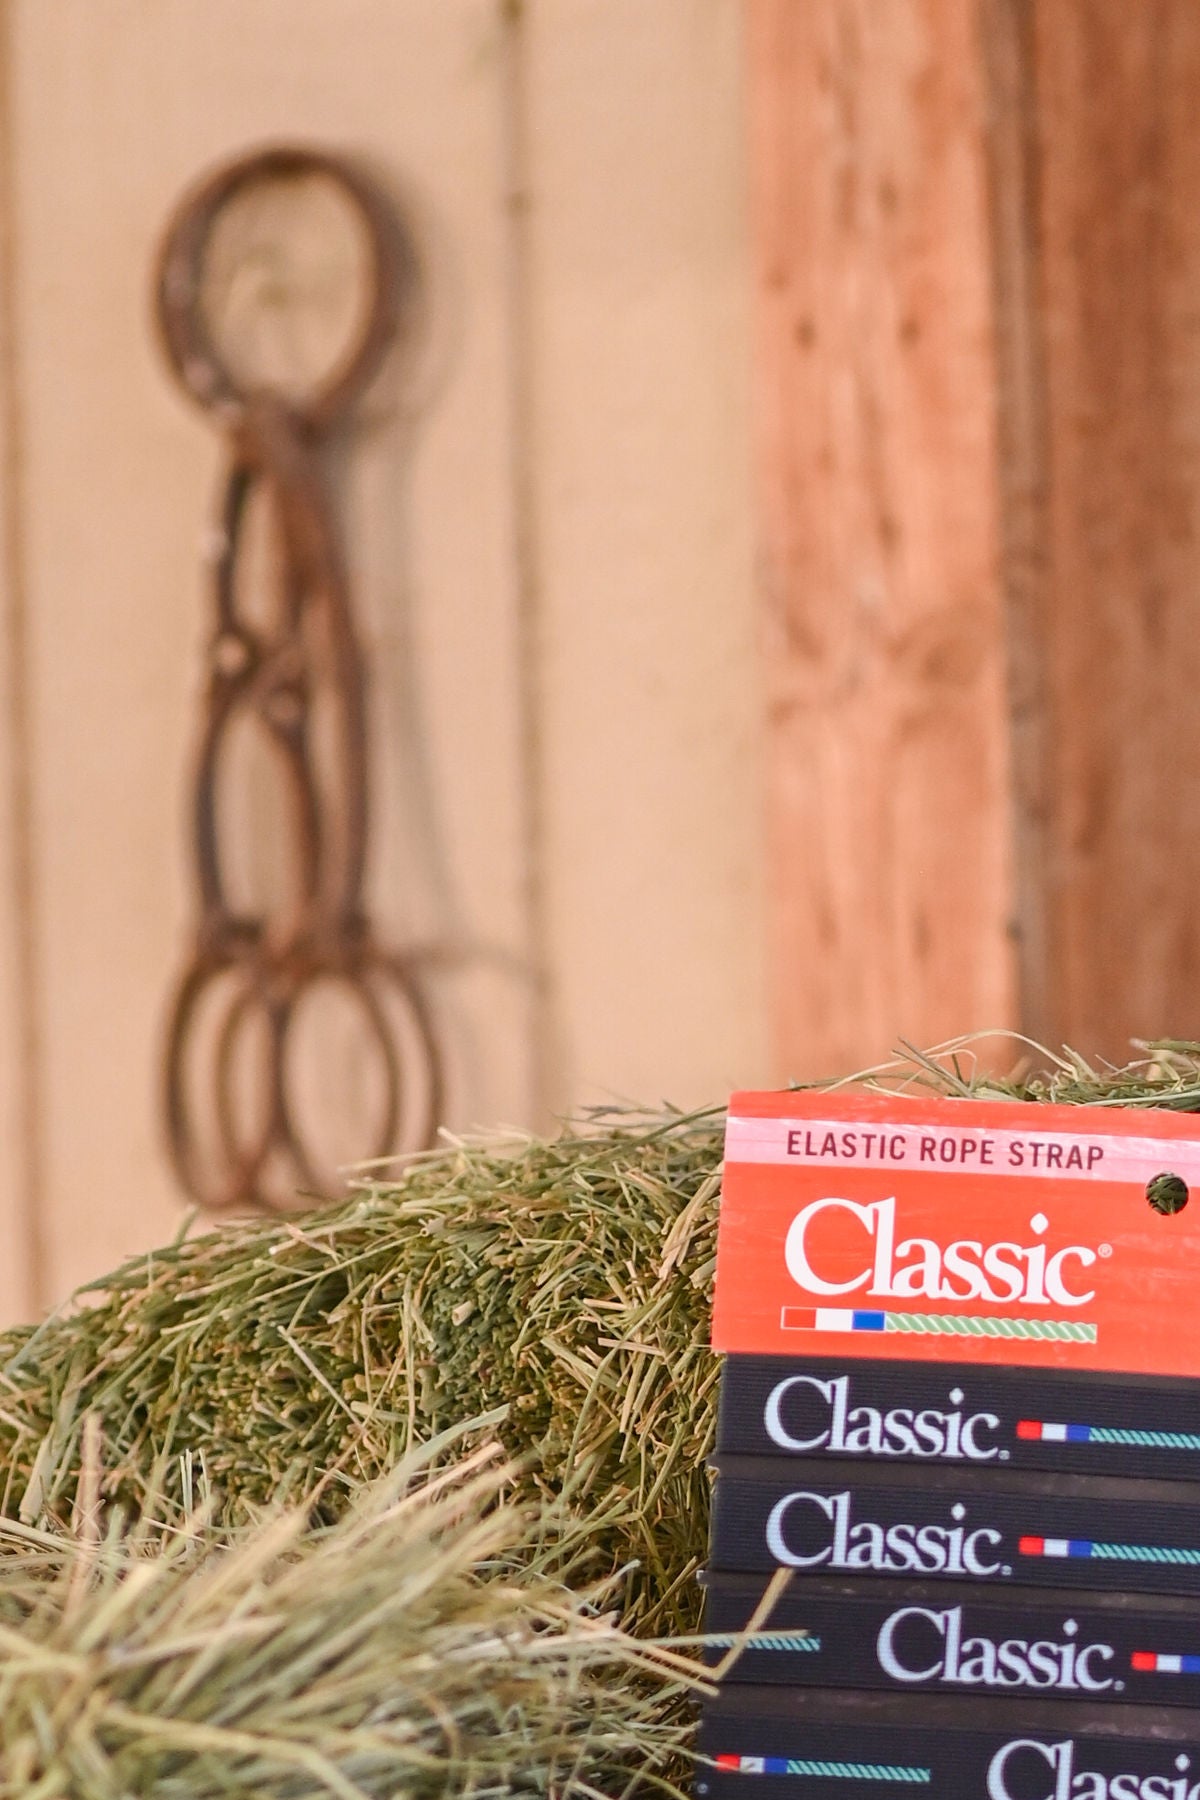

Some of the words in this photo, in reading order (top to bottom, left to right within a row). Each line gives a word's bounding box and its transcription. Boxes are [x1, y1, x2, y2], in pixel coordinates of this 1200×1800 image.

[786, 1130, 906, 1161] ELASTIC
[919, 1136, 995, 1165] ROPE
[1008, 1140, 1105, 1171] STRAP
[784, 1196, 1097, 1306] Classic
[764, 1375, 1000, 1460] Classic
[766, 1491, 1002, 1576] Classic
[876, 1605, 1114, 1691] Classic
